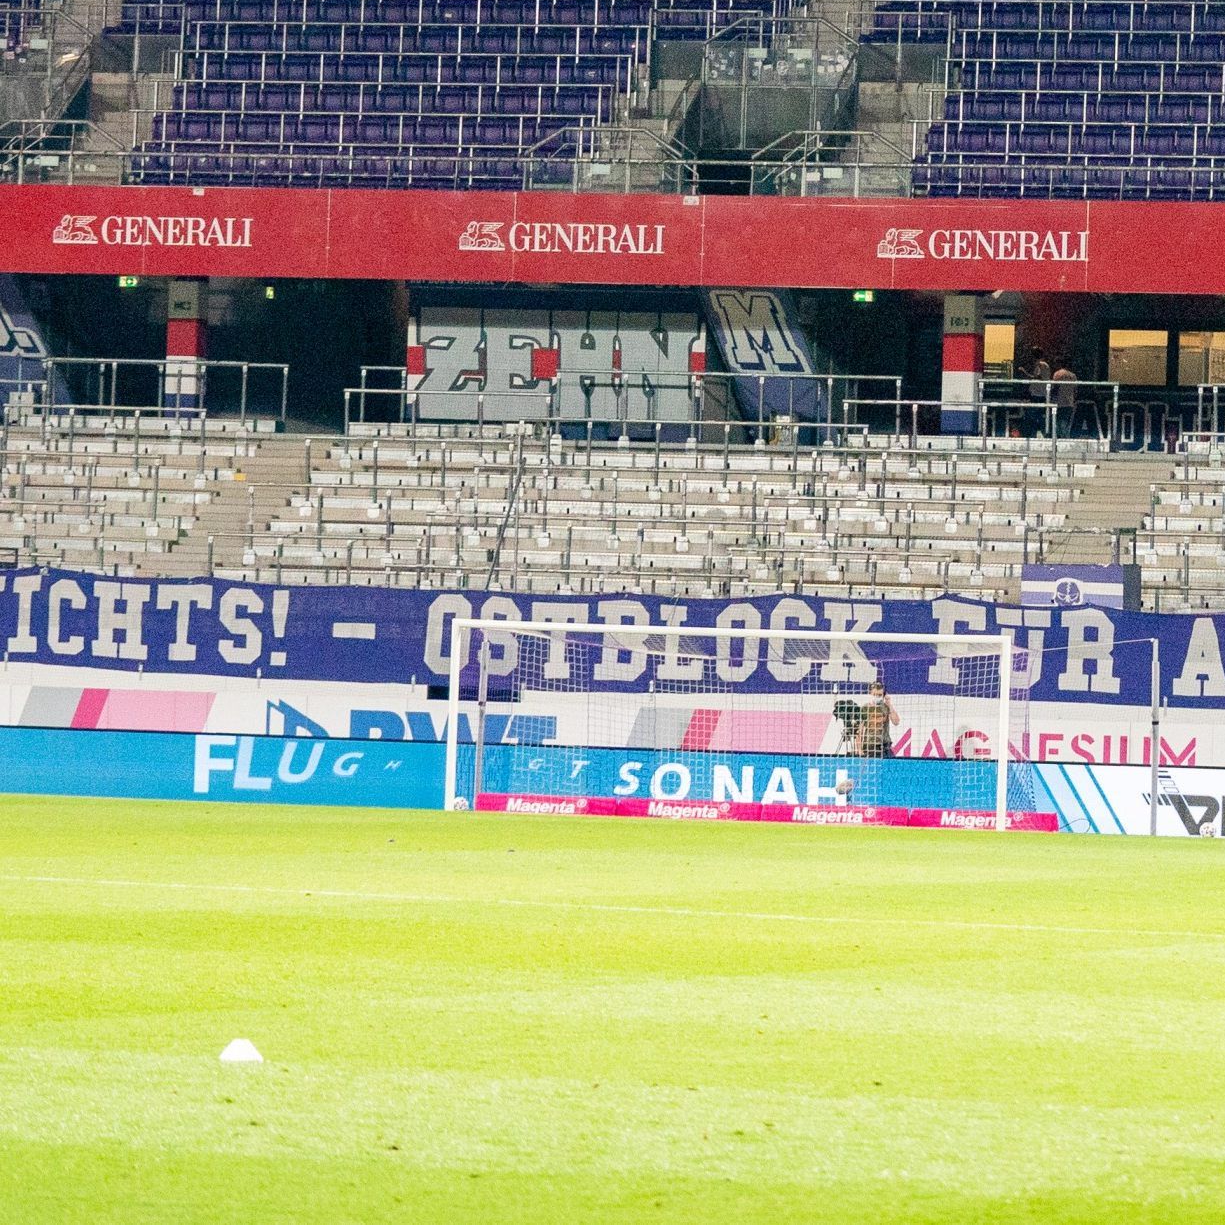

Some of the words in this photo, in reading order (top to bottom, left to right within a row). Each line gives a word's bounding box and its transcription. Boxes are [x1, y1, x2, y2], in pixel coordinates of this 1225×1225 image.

[102, 214, 254, 249] GENERALI
[508, 222, 666, 256] GENERALI
[928, 228, 1090, 263] GENERALI
[0, 574, 290, 666] ICHTS!
[423, 592, 883, 684] OSTBLOCK
[928, 594, 1121, 695] FÜR
[613, 761, 692, 801] SO
